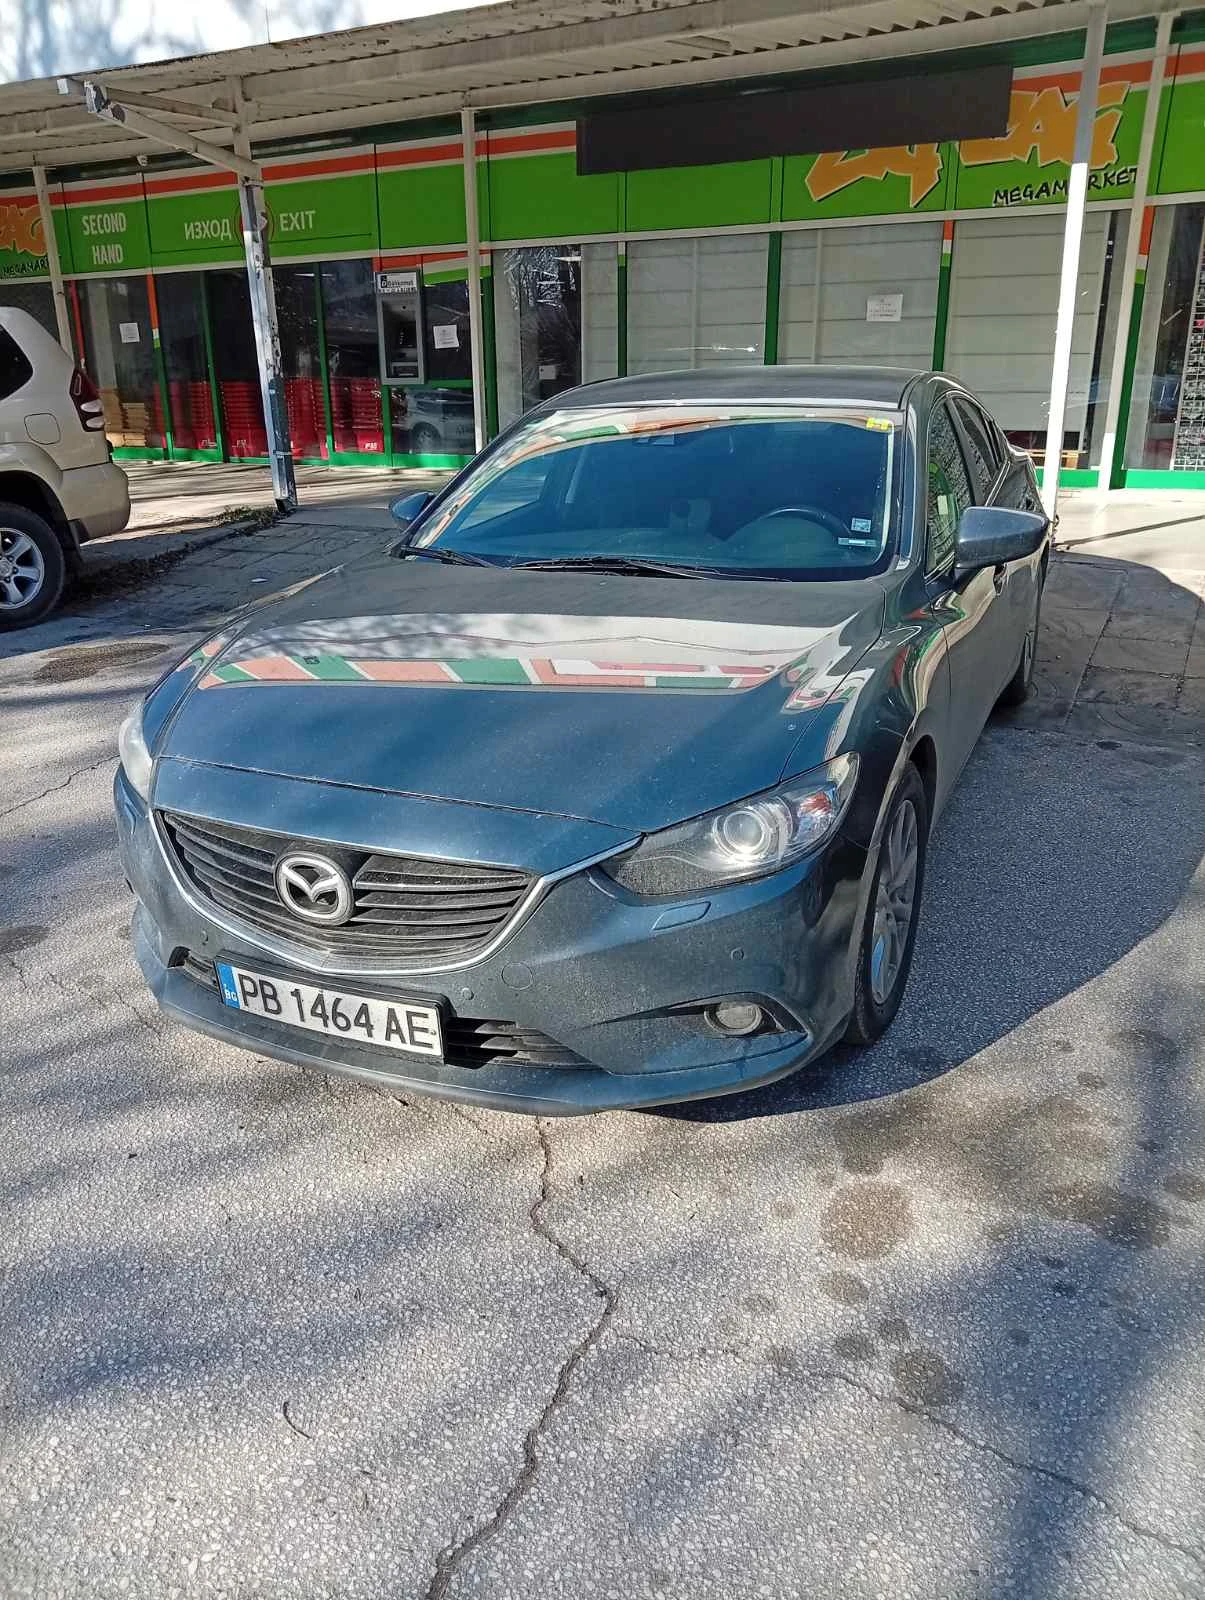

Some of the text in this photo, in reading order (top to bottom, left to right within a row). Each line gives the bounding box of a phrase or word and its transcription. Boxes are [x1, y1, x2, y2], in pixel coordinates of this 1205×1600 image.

[993, 167, 1138, 206] MEGAMRKET
[81, 212, 127, 236] SECOND
[184, 218, 232, 241] ИЗХОД
[279, 210, 316, 232] EXIT
[92, 243, 124, 265] HAND
[238, 973, 433, 1049] PB 1464 AE
